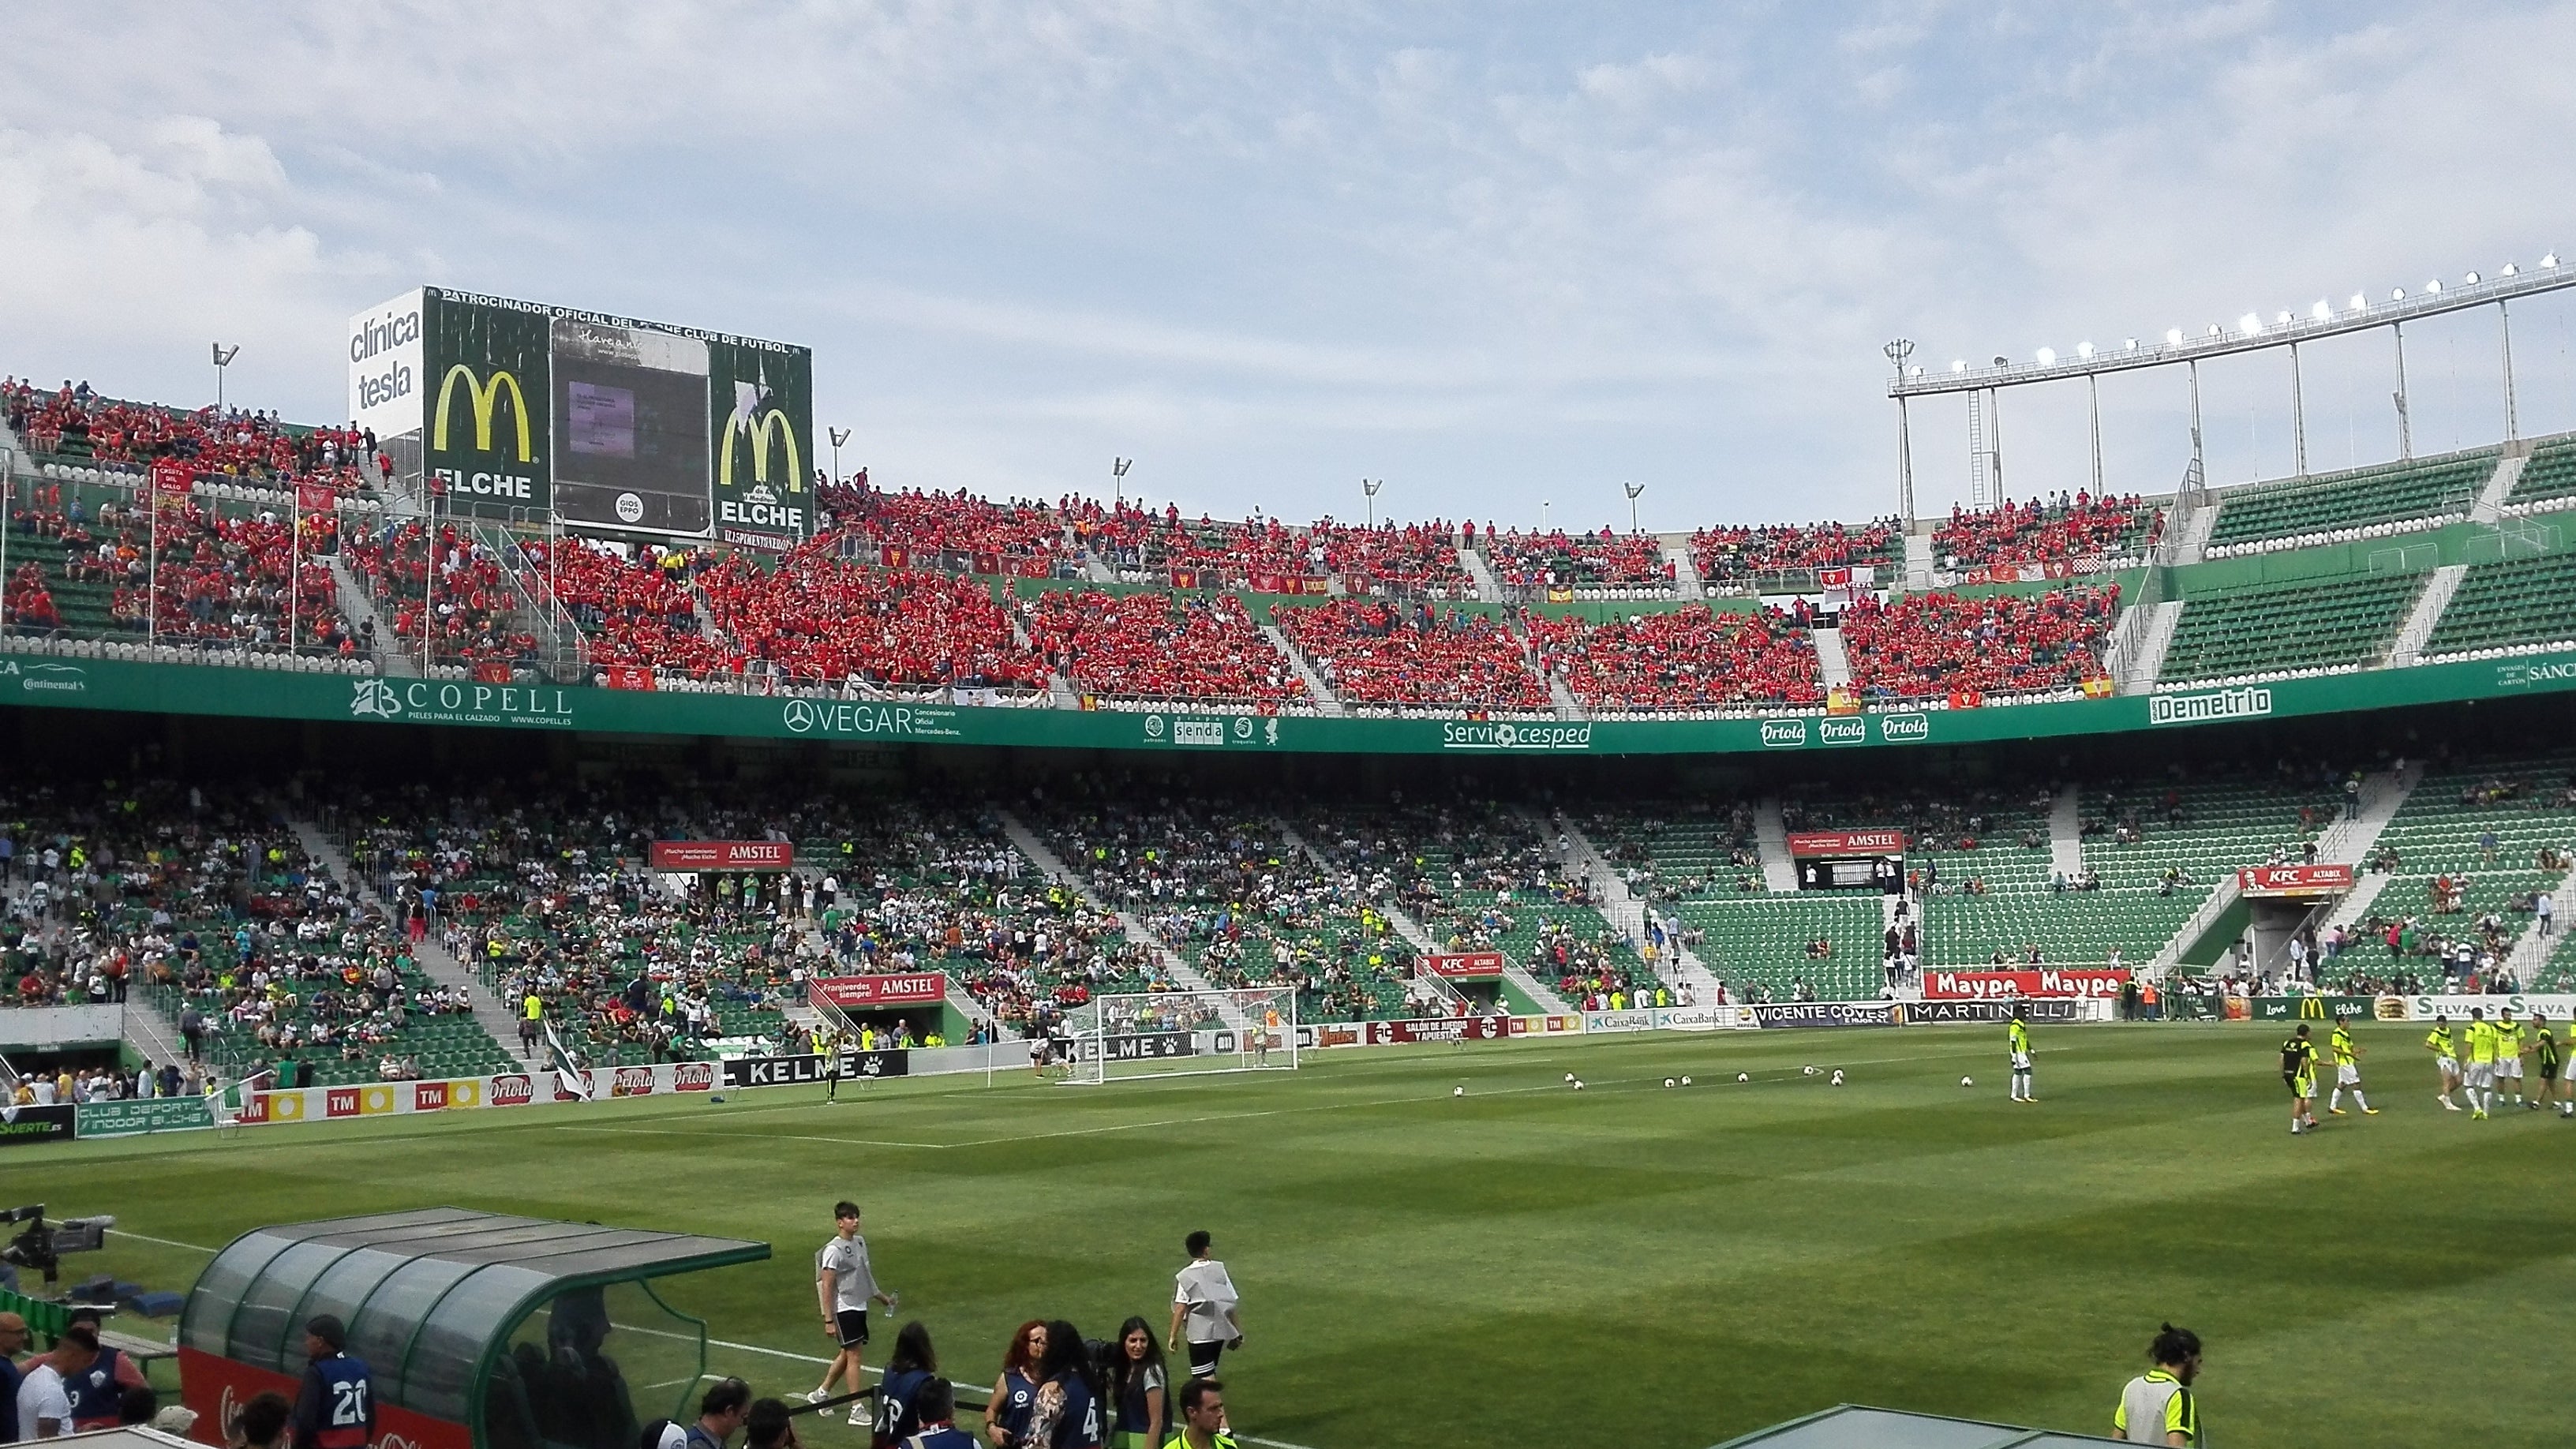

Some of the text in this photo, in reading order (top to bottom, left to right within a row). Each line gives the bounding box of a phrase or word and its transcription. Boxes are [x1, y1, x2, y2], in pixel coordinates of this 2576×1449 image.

[443, 290, 551, 316] PATROCINADOR
[556, 307, 608, 324] OFICIAL
[612, 316, 635, 328] DEL
[684, 328, 718, 341] CLUB
[722, 333, 737, 345] DE
[741, 337, 788, 354] FUTBOL
[350, 312, 419, 363] clínica
[359, 361, 410, 410] tesla
[721, 500, 803, 528] ELCHE
[2529, 662, 2576, 681] SÁNC
[23, 678, 77, 691] Continental
[407, 683, 572, 714] COPELL
[2159, 690, 2269, 721] Demetrio
[408, 711, 432, 720] PIELES
[434, 712, 454, 721] PARA
[465, 713, 500, 722] CALZADO
[511, 716, 571, 725] WWW.COPELL.ES
[816, 704, 912, 734] VEGAR
[915, 708, 956, 717] Concesionario
[1177, 723, 1222, 736] senda
[1761, 719, 1928, 740] Ortola Ortola Ortola
[1848, 834, 1895, 846] AMSTEL
[728, 846, 781, 859] AMSTEL
[2269, 871, 2300, 882] KFC
[1441, 959, 1465, 969] KFC
[881, 978, 934, 994] AMSTEL
[1938, 972, 2118, 998] Maype Maype
[1758, 1005, 1889, 1021] VICENTE COVES
[2266, 1004, 2286, 1016] Love
[2335, 1002, 2363, 1016] Elche
[1430, 1022, 1440, 1031] DE
[1512, 1020, 1524, 1031] TM
[1549, 1019, 1560, 1029] TM
[1673, 1013, 1720, 1025] CaixaBank
[672, 1068, 713, 1086] Ortola
[419, 1089, 442, 1106] TM
[489, 1081, 534, 1099] Ortola
[331, 1095, 354, 1111] TM
[1083, 1397, 1098, 1442] 4
